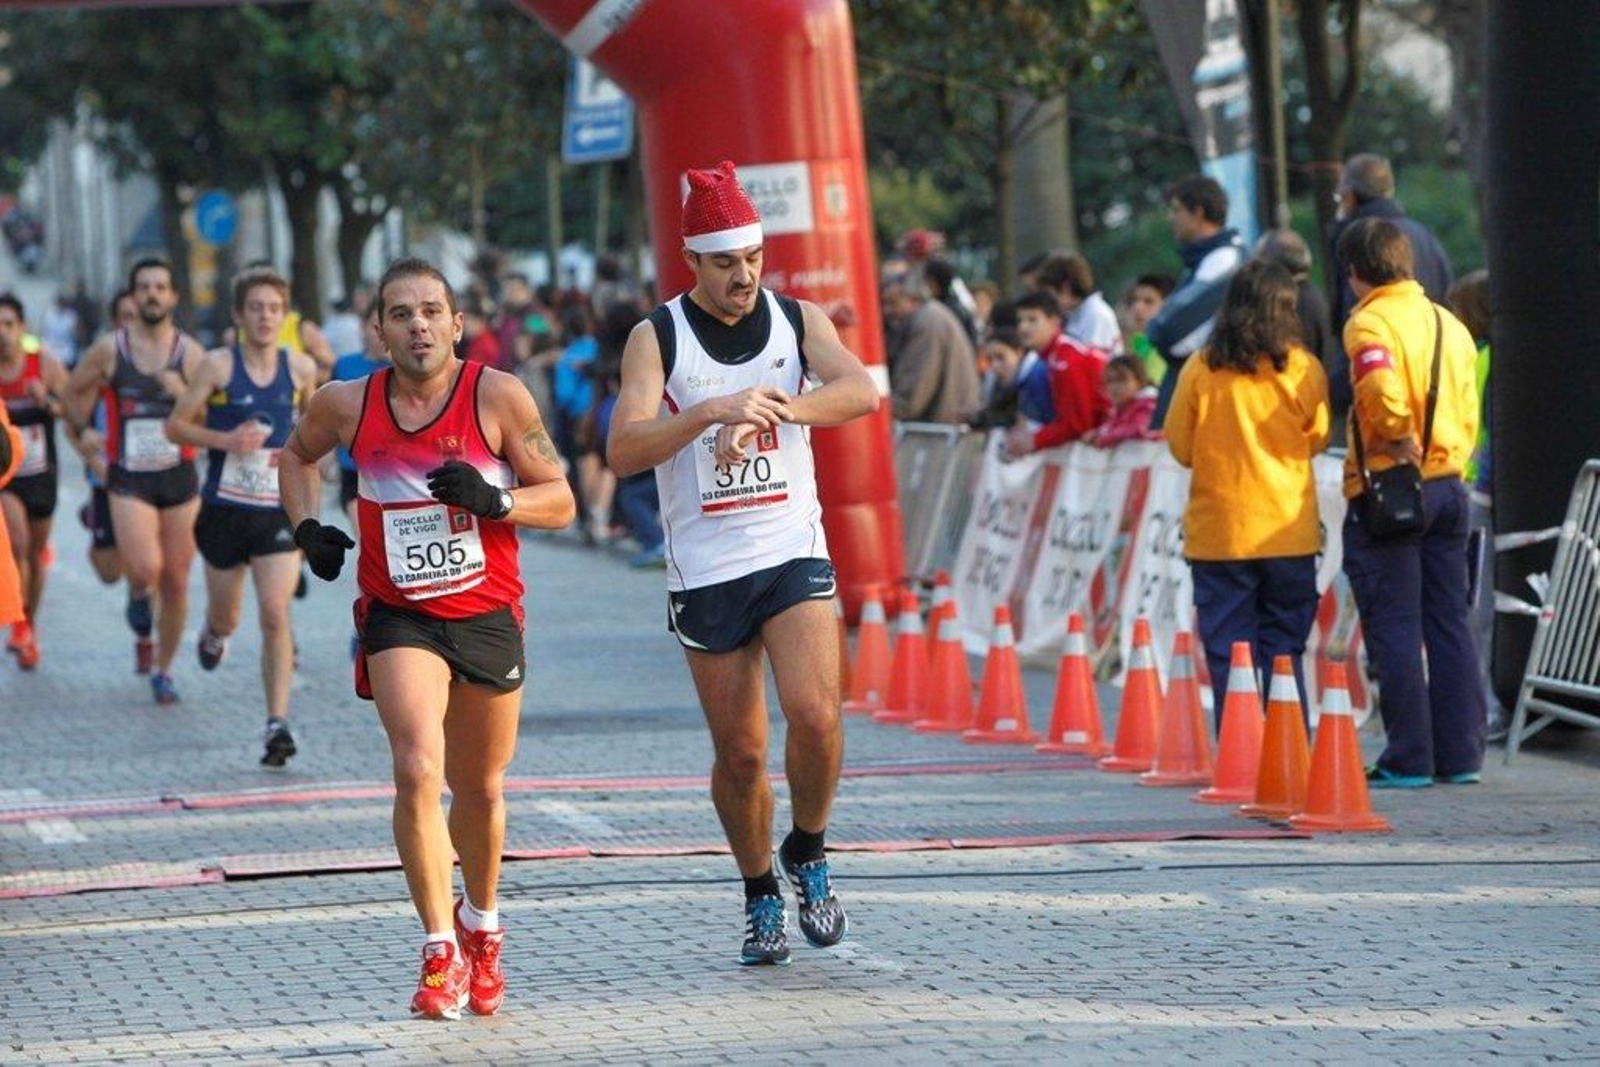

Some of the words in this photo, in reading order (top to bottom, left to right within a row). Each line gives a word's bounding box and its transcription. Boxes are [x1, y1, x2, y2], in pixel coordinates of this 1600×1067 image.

[746, 176, 800, 197] ELLO
[715, 456, 771, 488] 370
[702, 492, 713, 500] 53
[714, 486, 755, 498] CARREIRA
[756, 484, 768, 493] DO
[769, 481, 788, 491] PAVO
[393, 513, 441, 527] CONCELLO
[399, 527, 411, 536] DE
[413, 523, 437, 533] VIGO
[406, 538, 467, 571] 505
[392, 574, 404, 583] 53
[405, 569, 449, 581] CARREIRA
[449, 567, 462, 576] DO
